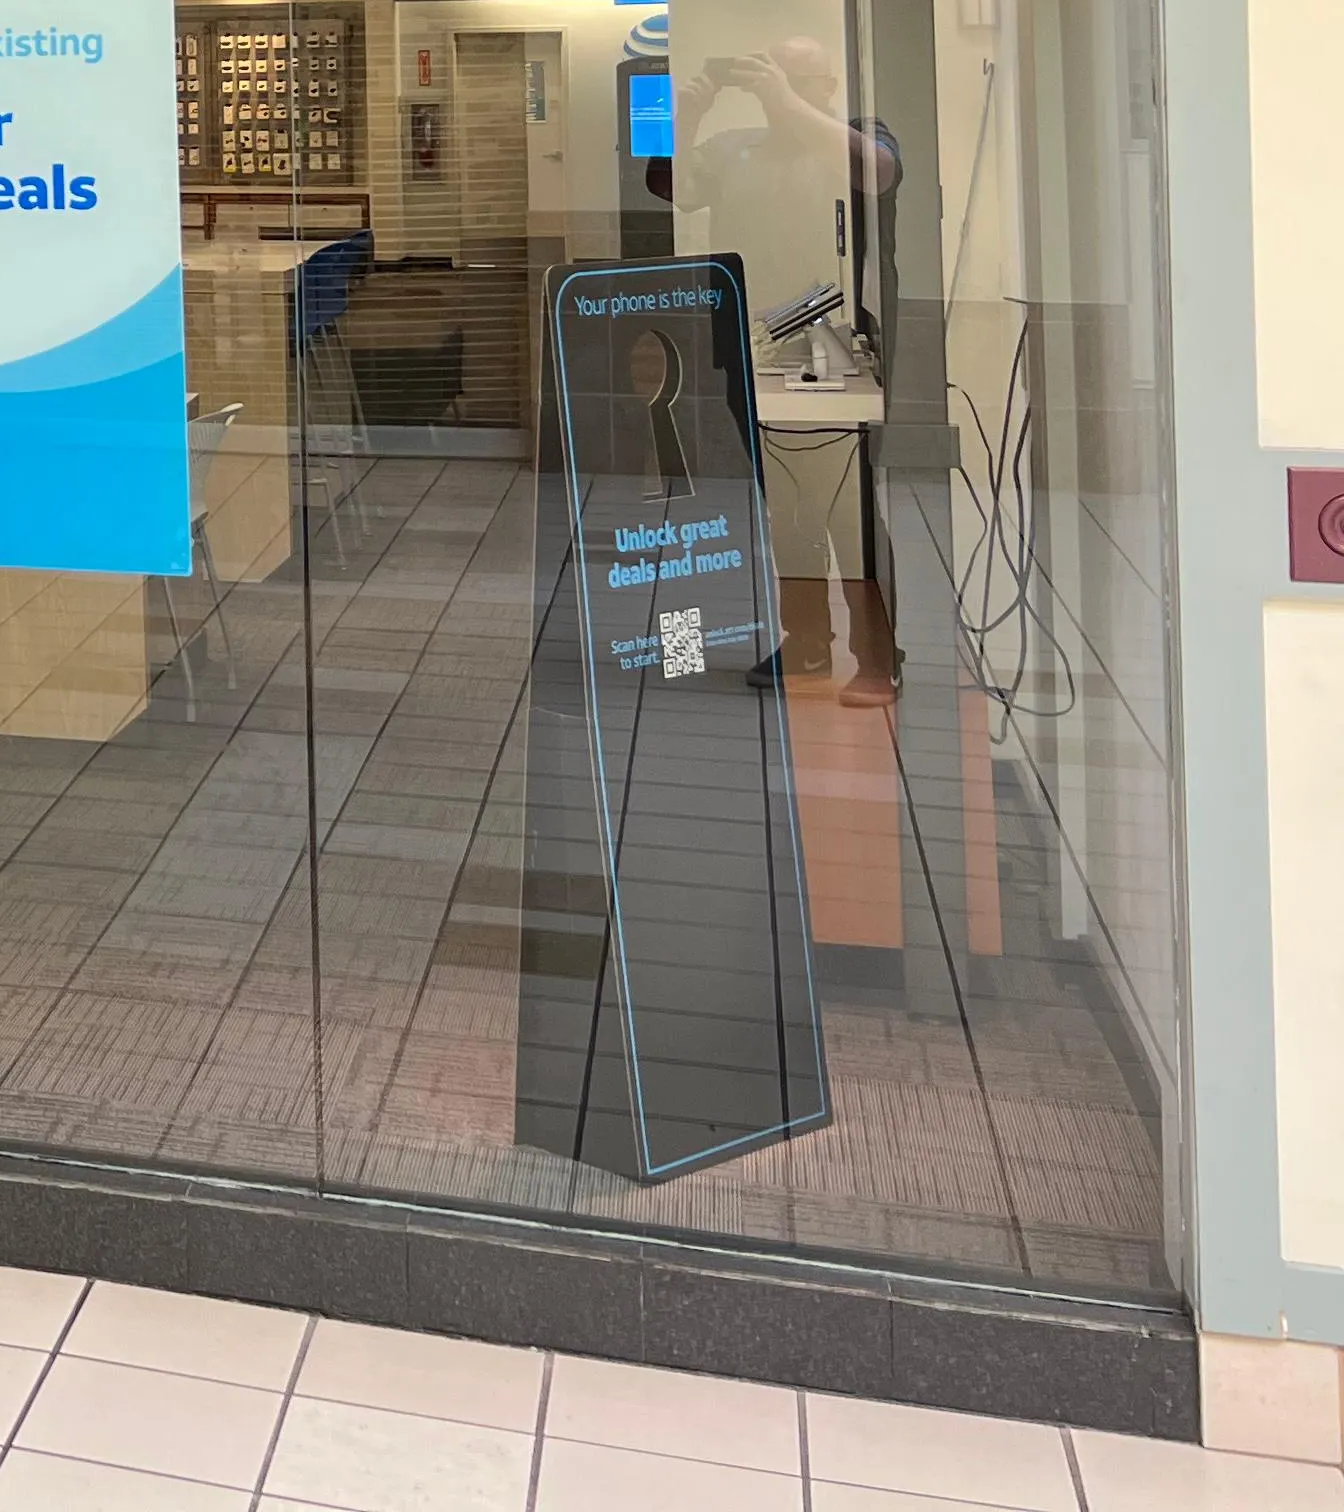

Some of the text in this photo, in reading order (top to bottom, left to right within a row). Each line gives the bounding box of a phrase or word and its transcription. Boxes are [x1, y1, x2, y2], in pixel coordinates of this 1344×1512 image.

[574, 285, 723, 319] Your phone is the key
[615, 513, 729, 552] Unlock great
[608, 549, 743, 588] deals and more
[611, 635, 658, 655] Scan here
[620, 657, 632, 670] to
